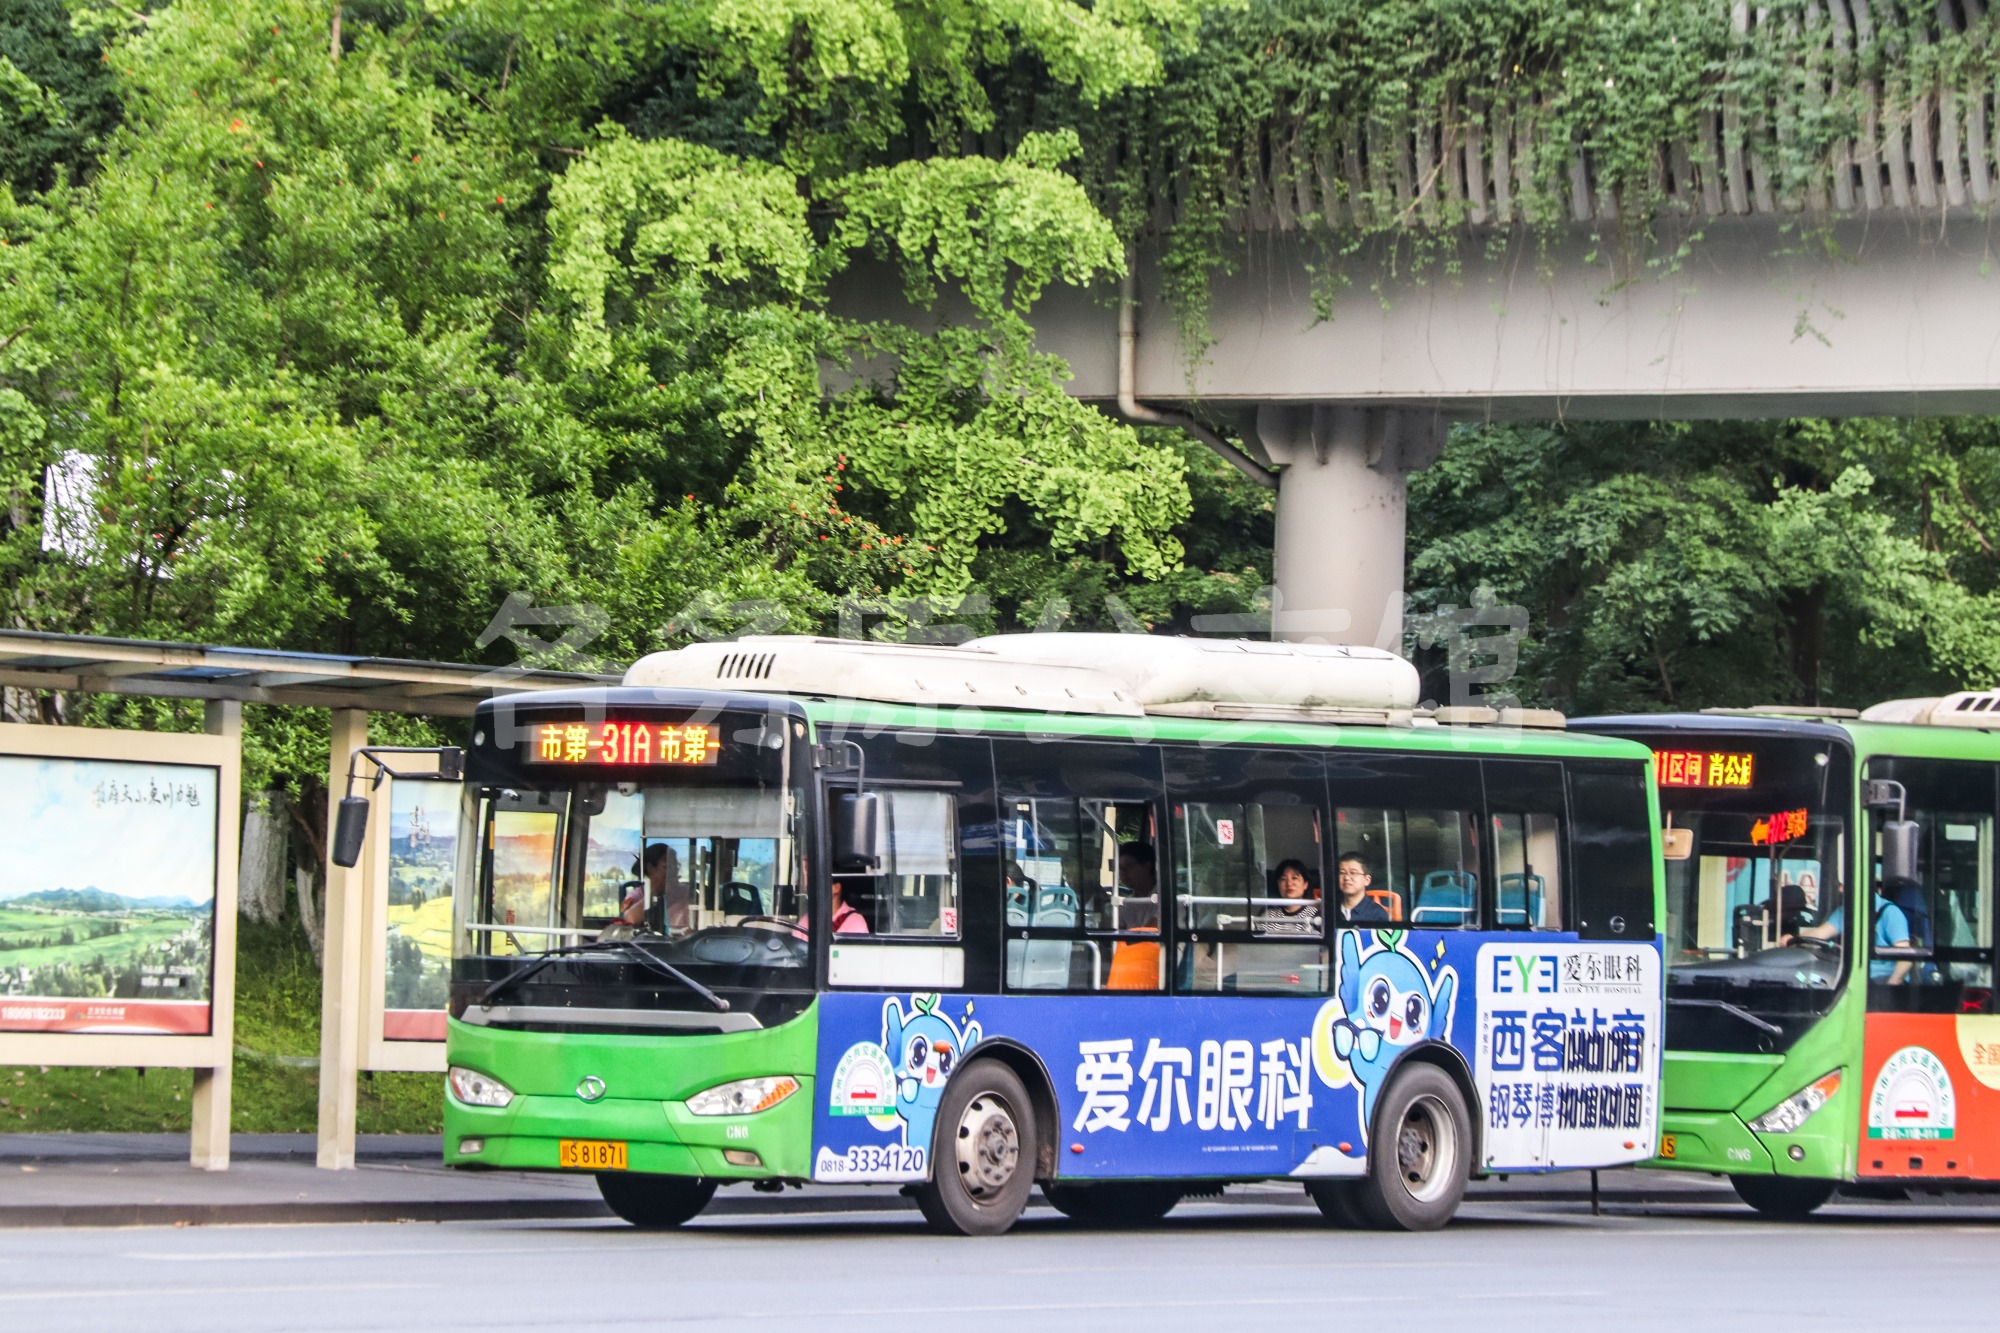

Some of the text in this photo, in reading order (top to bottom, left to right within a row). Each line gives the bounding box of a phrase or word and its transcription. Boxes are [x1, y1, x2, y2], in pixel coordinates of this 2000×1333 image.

[1493, 955, 1558, 993] EYE
[1563, 953, 1643, 982] 爱尔眼科
[1072, 1037, 1313, 1134] 爱尔眼科
[726, 1126, 749, 1139] CNG
[1727, 1148, 1752, 1161] CNG
